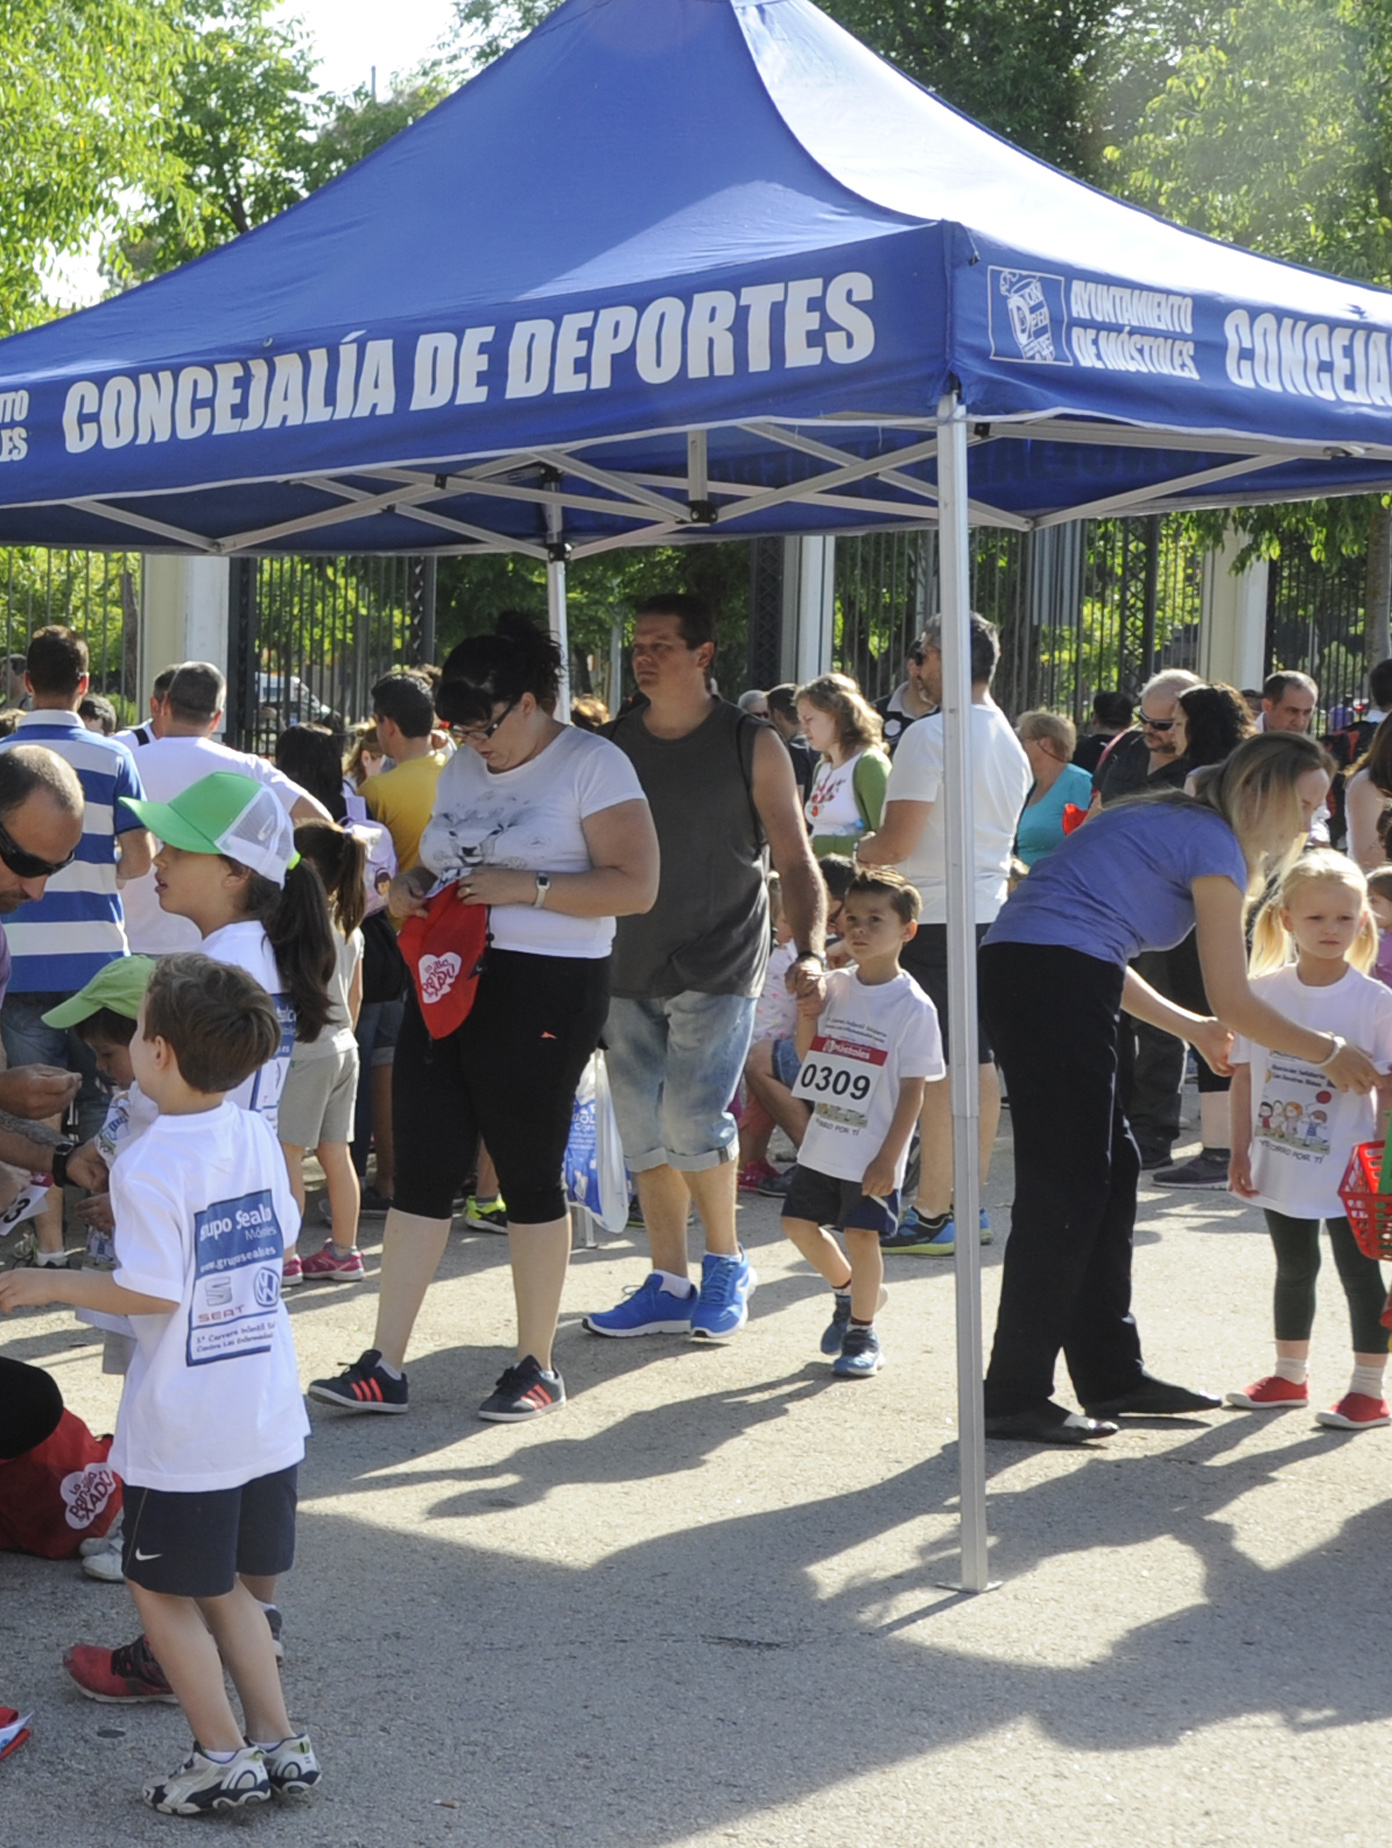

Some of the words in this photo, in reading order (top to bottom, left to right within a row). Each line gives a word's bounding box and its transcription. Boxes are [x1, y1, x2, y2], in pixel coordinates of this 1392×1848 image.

[1070, 279, 1193, 334] AYUNTAMIENTO
[63, 329, 396, 454] CONCEJALÍA
[409, 326, 496, 412] DE
[505, 271, 876, 400] DEPORTES
[1071, 326, 1106, 369] DE
[1097, 325, 1201, 380] MÓSTOLES
[1223, 308, 1392, 407] CONCEJA
[800, 1063, 871, 1101] 0309
[198, 1304, 245, 1323] SEAT
